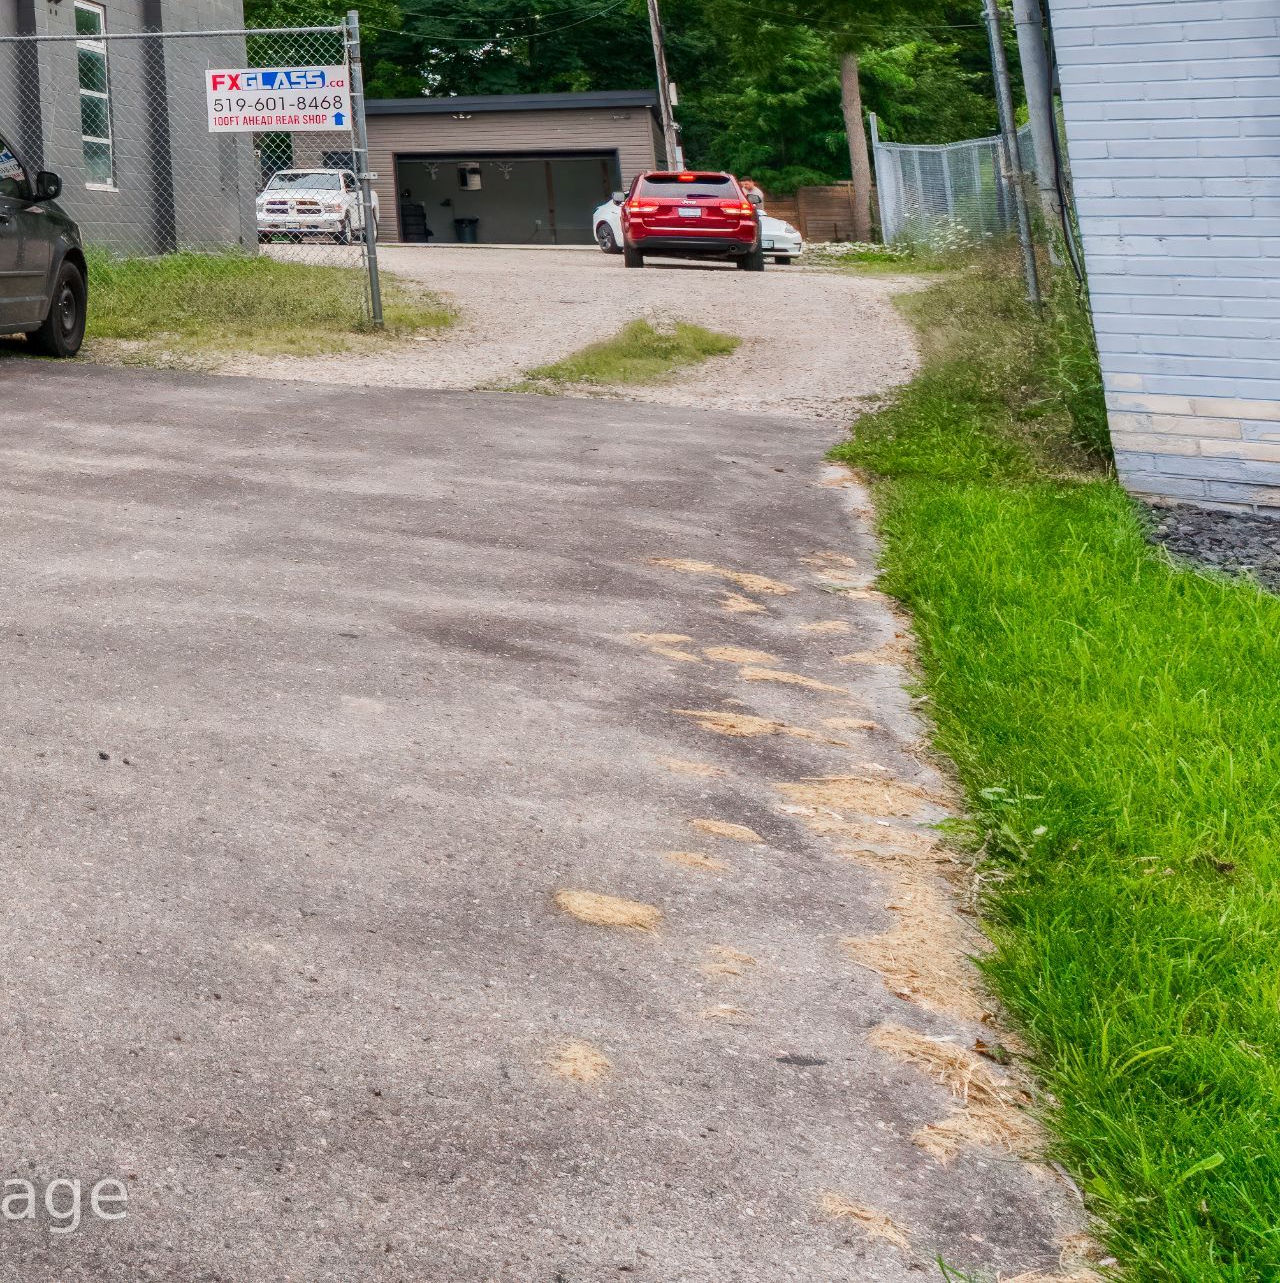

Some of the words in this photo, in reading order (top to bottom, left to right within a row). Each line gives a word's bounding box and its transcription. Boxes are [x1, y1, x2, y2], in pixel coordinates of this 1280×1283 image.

[213, 95, 343, 112] 519-601-8468
[213, 116, 240, 126] 100FT
[242, 115, 273, 126] AHEAD
[275, 114, 300, 125] REAR
[301, 114, 327, 125] SHOP
